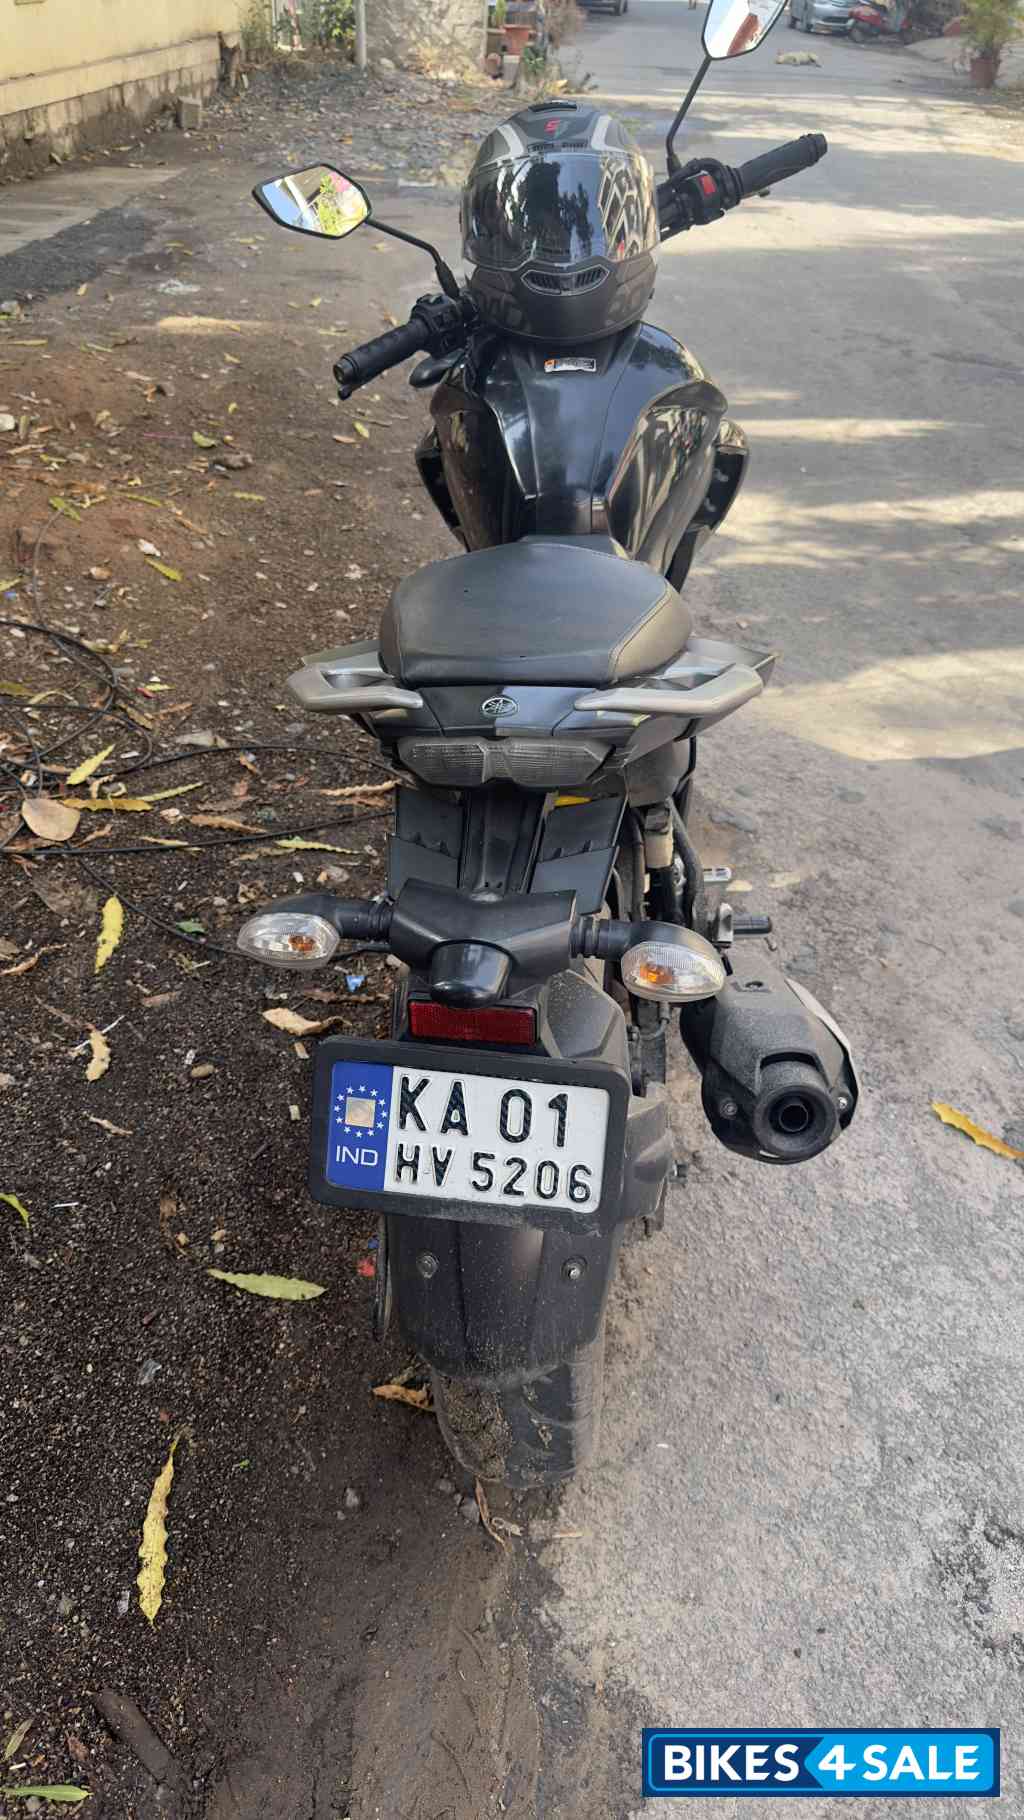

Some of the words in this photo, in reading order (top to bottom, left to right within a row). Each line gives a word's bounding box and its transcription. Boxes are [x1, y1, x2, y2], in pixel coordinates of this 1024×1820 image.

[399, 1076, 470, 1136] KA
[498, 1088, 569, 1148] 01
[335, 1145, 379, 1167] IND
[471, 1152, 593, 1203] 5206
